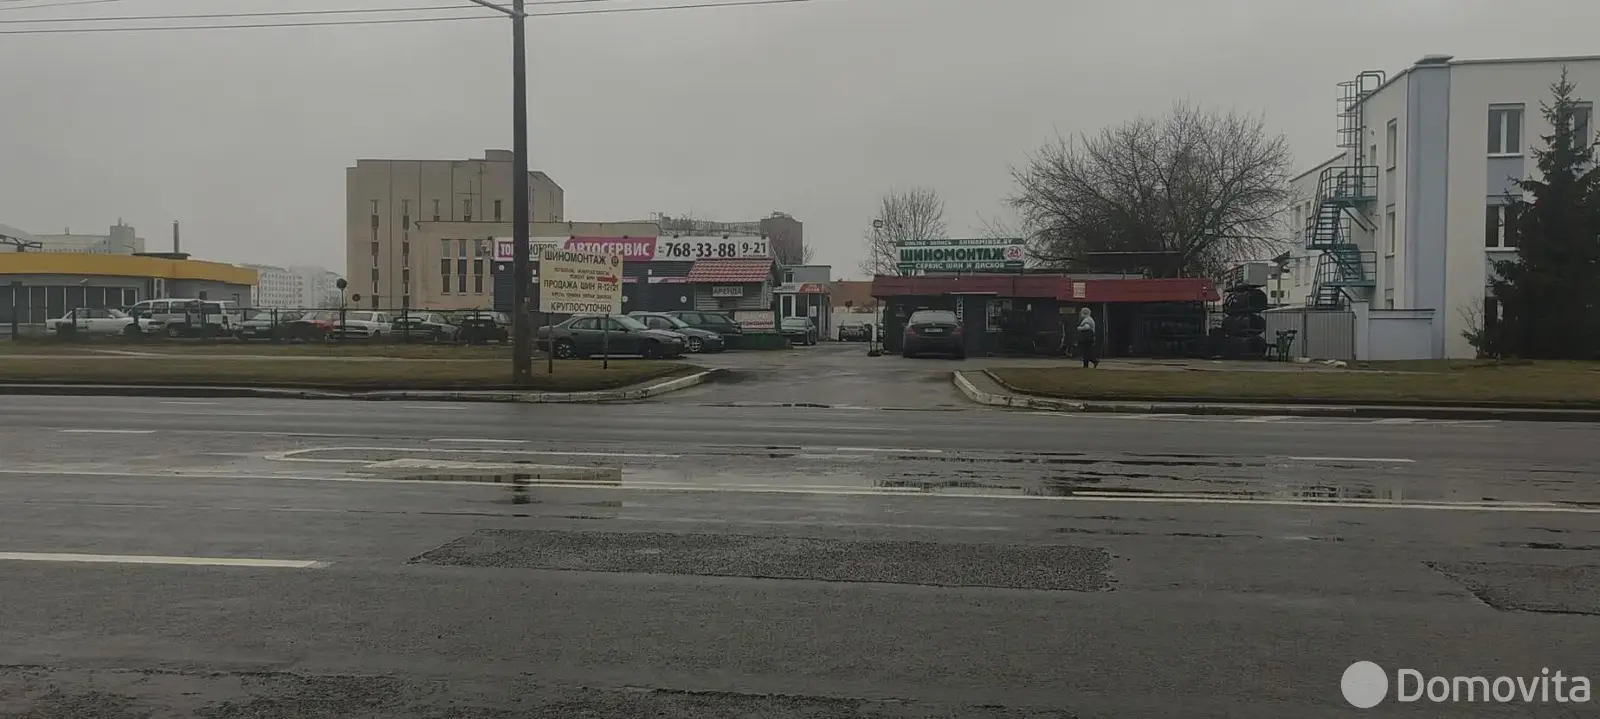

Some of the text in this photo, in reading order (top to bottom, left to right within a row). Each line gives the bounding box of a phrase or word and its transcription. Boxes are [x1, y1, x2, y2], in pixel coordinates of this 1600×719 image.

[500, 243, 513, 256] TO
[568, 242, 650, 256] АВТОСЕРВИС
[665, 243, 736, 257] 768-33-88
[742, 242, 766, 253] 9-21
[545, 250, 606, 265] ШИНОМОНТАЖ
[900, 248, 1005, 261] ШИНОМОНТАЖ
[544, 280, 577, 289] ПРОДАЖА
[580, 282, 595, 290] ШИН
[713, 286, 742, 295] АРЕНДА
[551, 301, 612, 312] КРУГЛОСУТОЧНО
